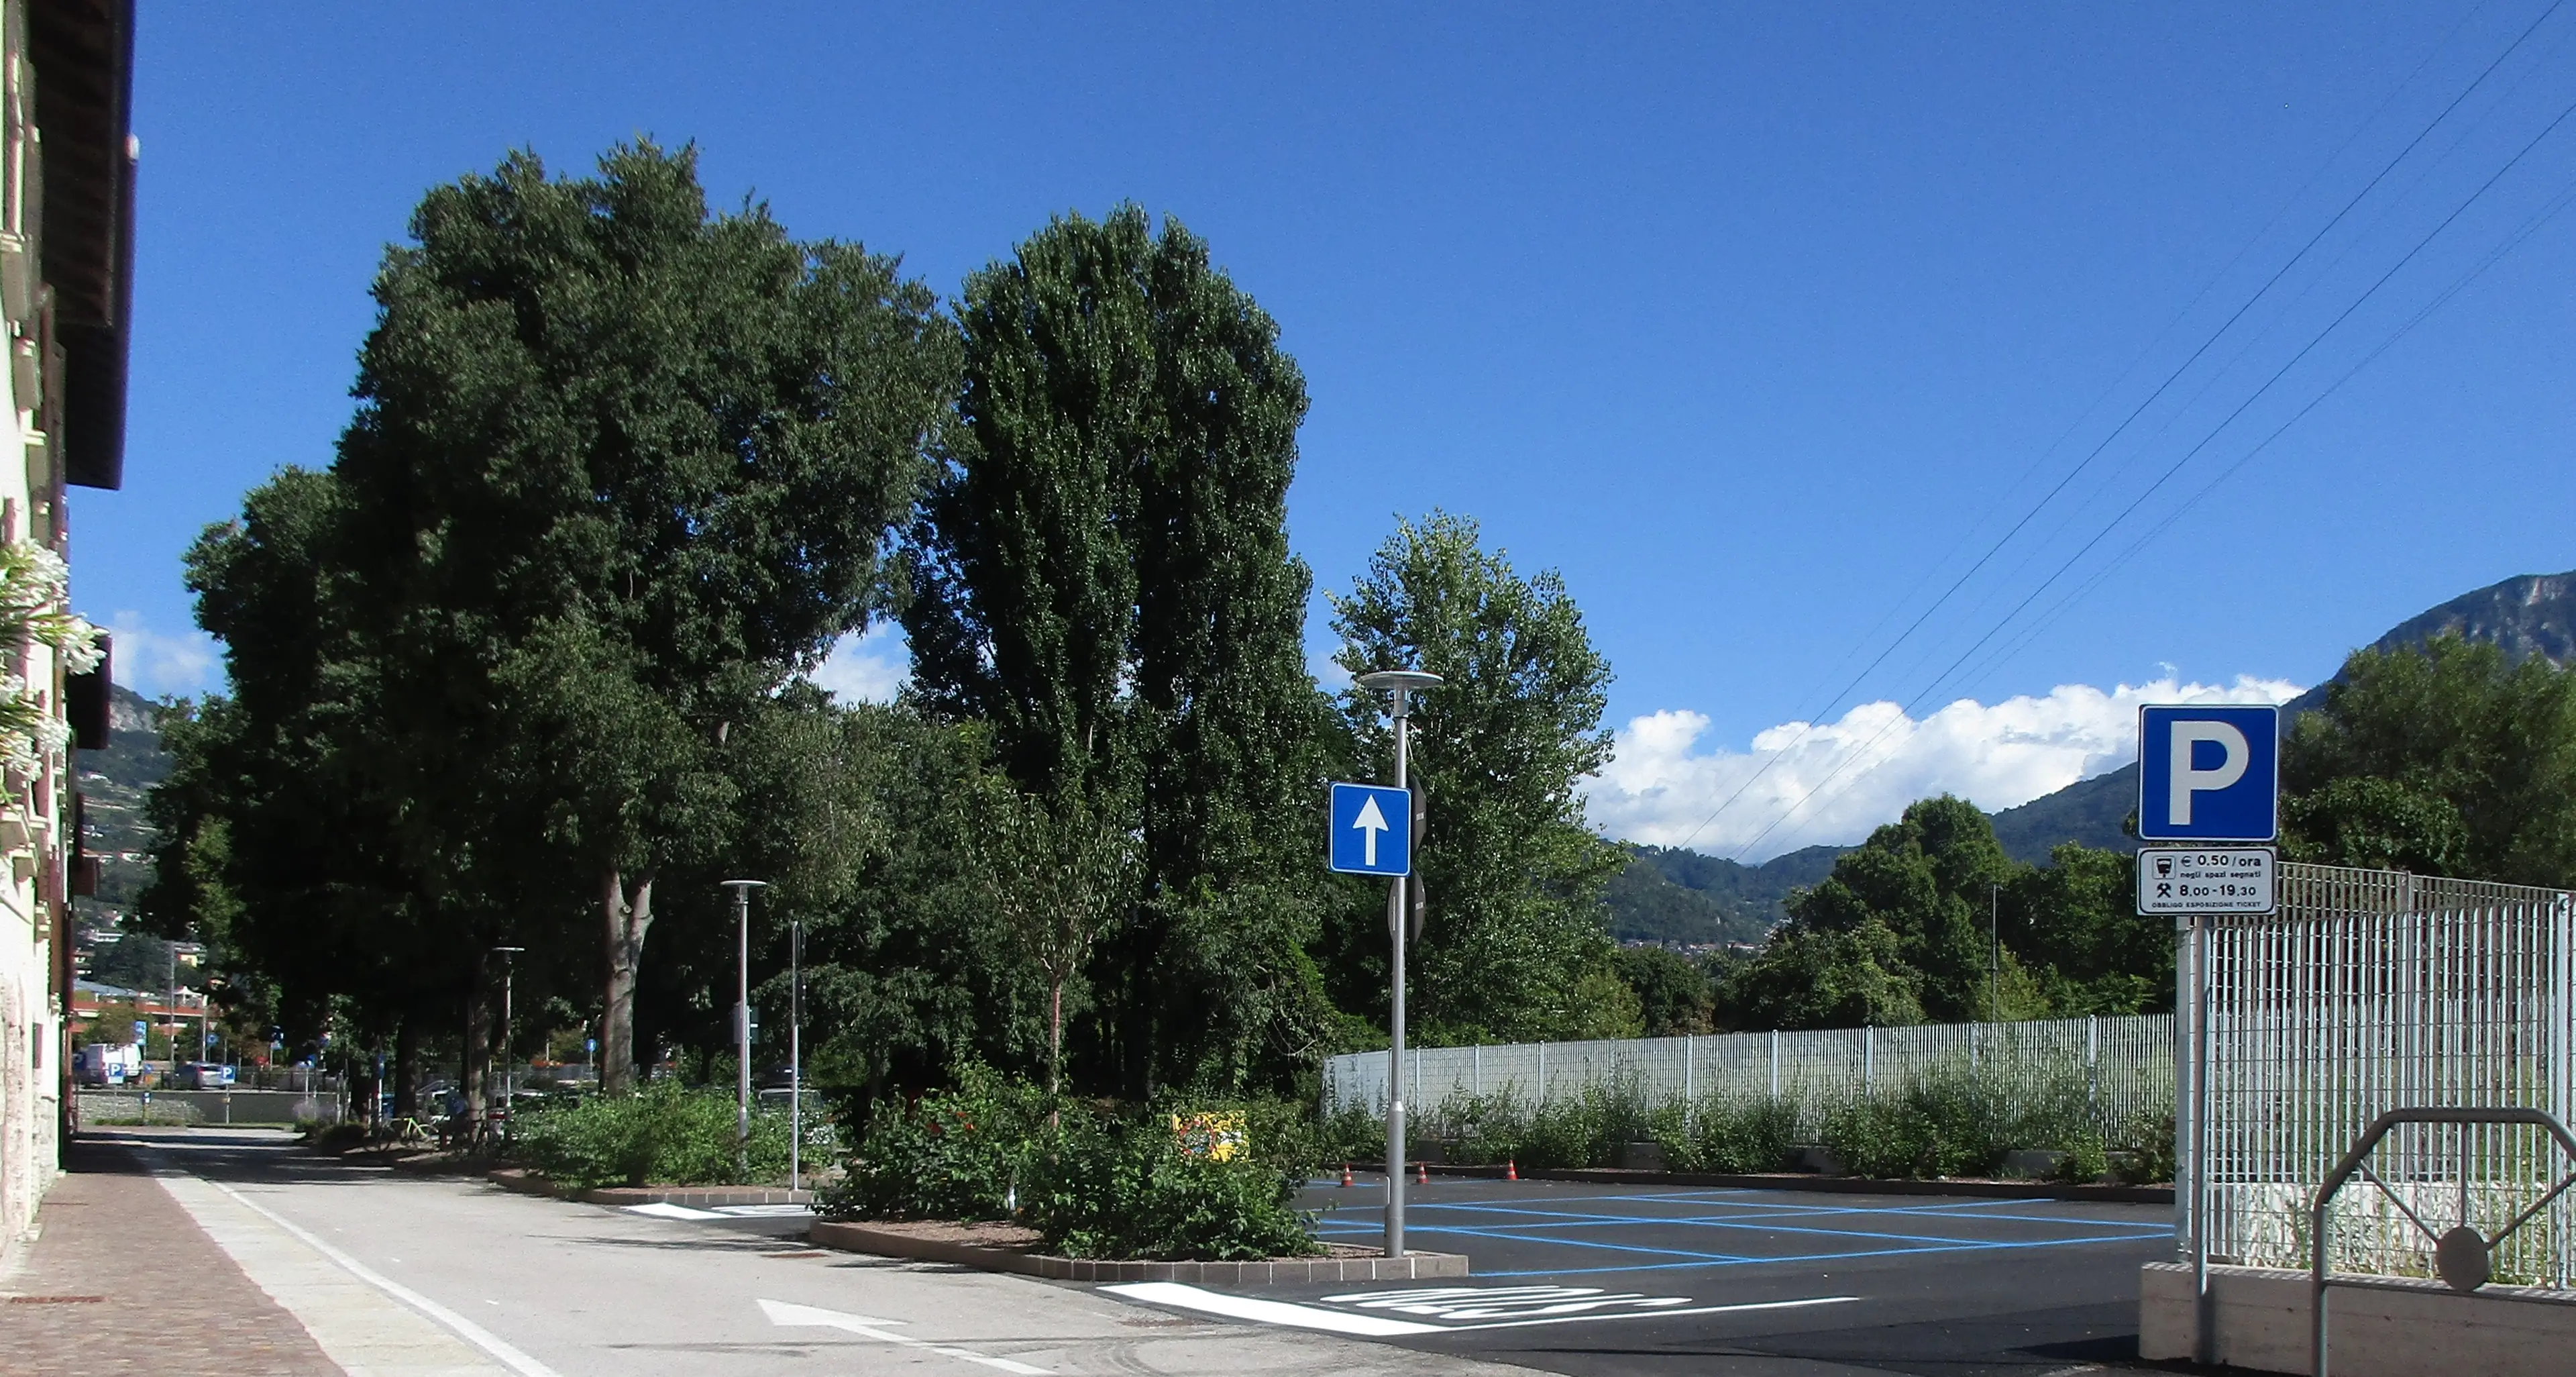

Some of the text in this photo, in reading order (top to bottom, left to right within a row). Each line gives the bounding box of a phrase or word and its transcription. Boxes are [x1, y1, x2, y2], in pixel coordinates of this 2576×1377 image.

[2169, 720, 2249, 825] P
[2180, 871, 2201, 879] negli
[2231, 871, 2261, 879] segnati
